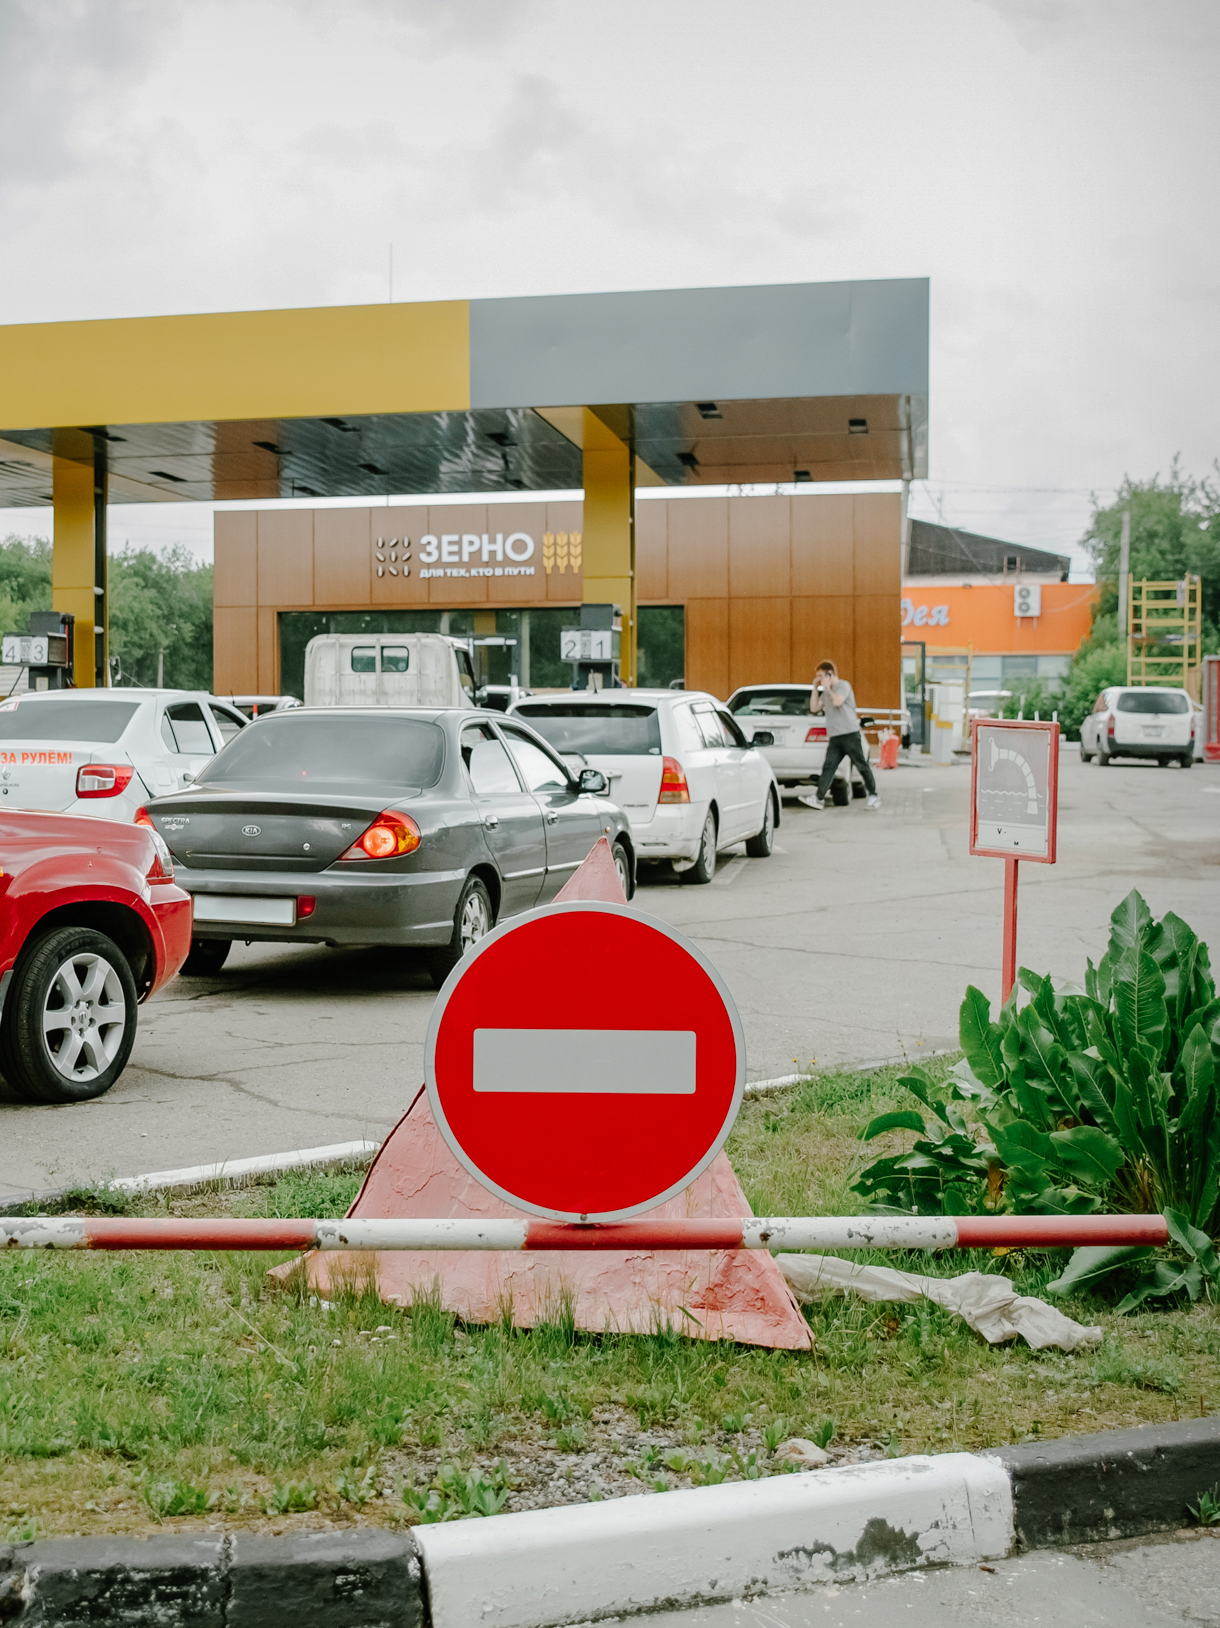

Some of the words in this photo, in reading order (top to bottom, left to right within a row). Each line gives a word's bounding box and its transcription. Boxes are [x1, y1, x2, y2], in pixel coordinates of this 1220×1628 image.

[419, 532, 535, 563] ЗЕРНО
[420, 568, 444, 578] ДЛЯ
[445, 568, 470, 577] ТЕХ,
[471, 567, 493, 577] КТО
[494, 567, 503, 576] В
[504, 566, 535, 576] ПУТИ
[5, 645, 16, 662] 4
[33, 645, 44, 661] 3
[565, 640, 576, 658] 2
[596, 640, 603, 658] 1
[0, 752, 17, 764] ЗА
[21, 750, 73, 765] РУЛЁМ!
[244, 826, 258, 834] KIA
